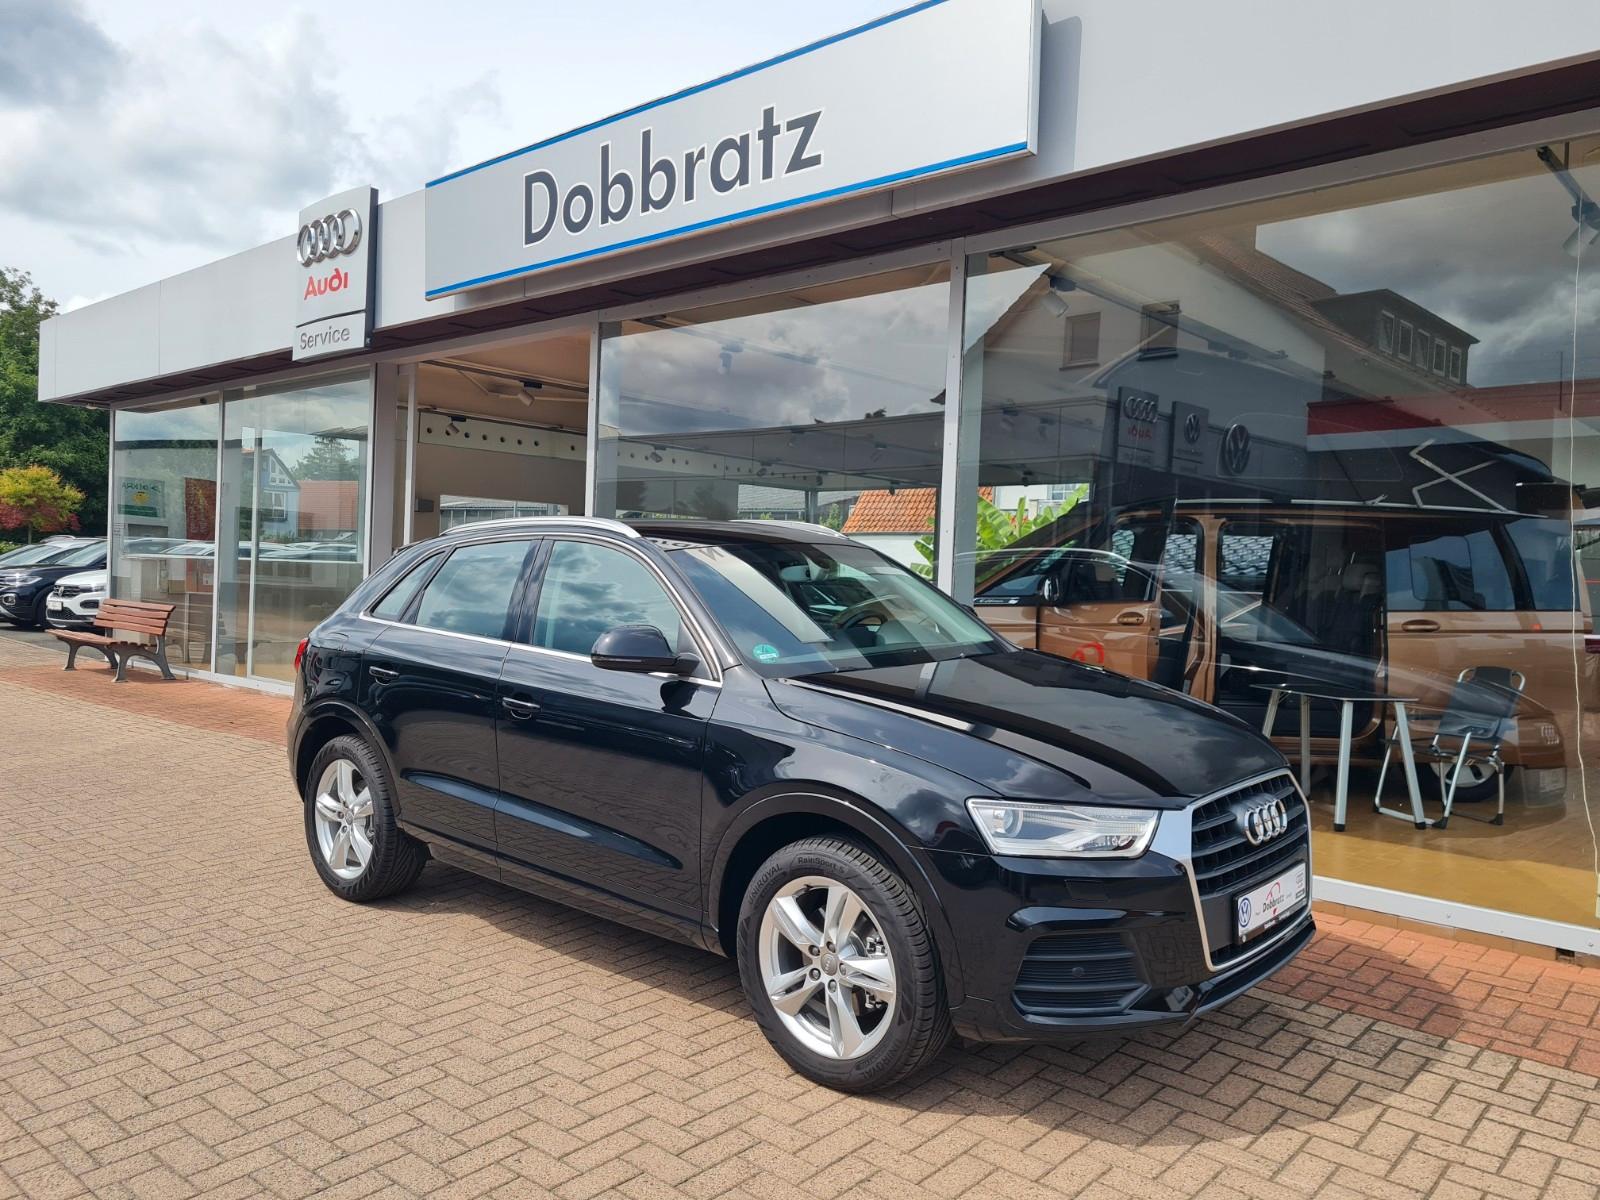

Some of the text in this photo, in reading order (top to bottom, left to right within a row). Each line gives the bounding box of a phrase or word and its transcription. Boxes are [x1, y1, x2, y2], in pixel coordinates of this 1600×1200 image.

[523, 105, 823, 246] Dobbratz
[304, 268, 349, 300] Audi
[301, 326, 350, 350] Service
[748, 863, 783, 905] UNIROYAL
